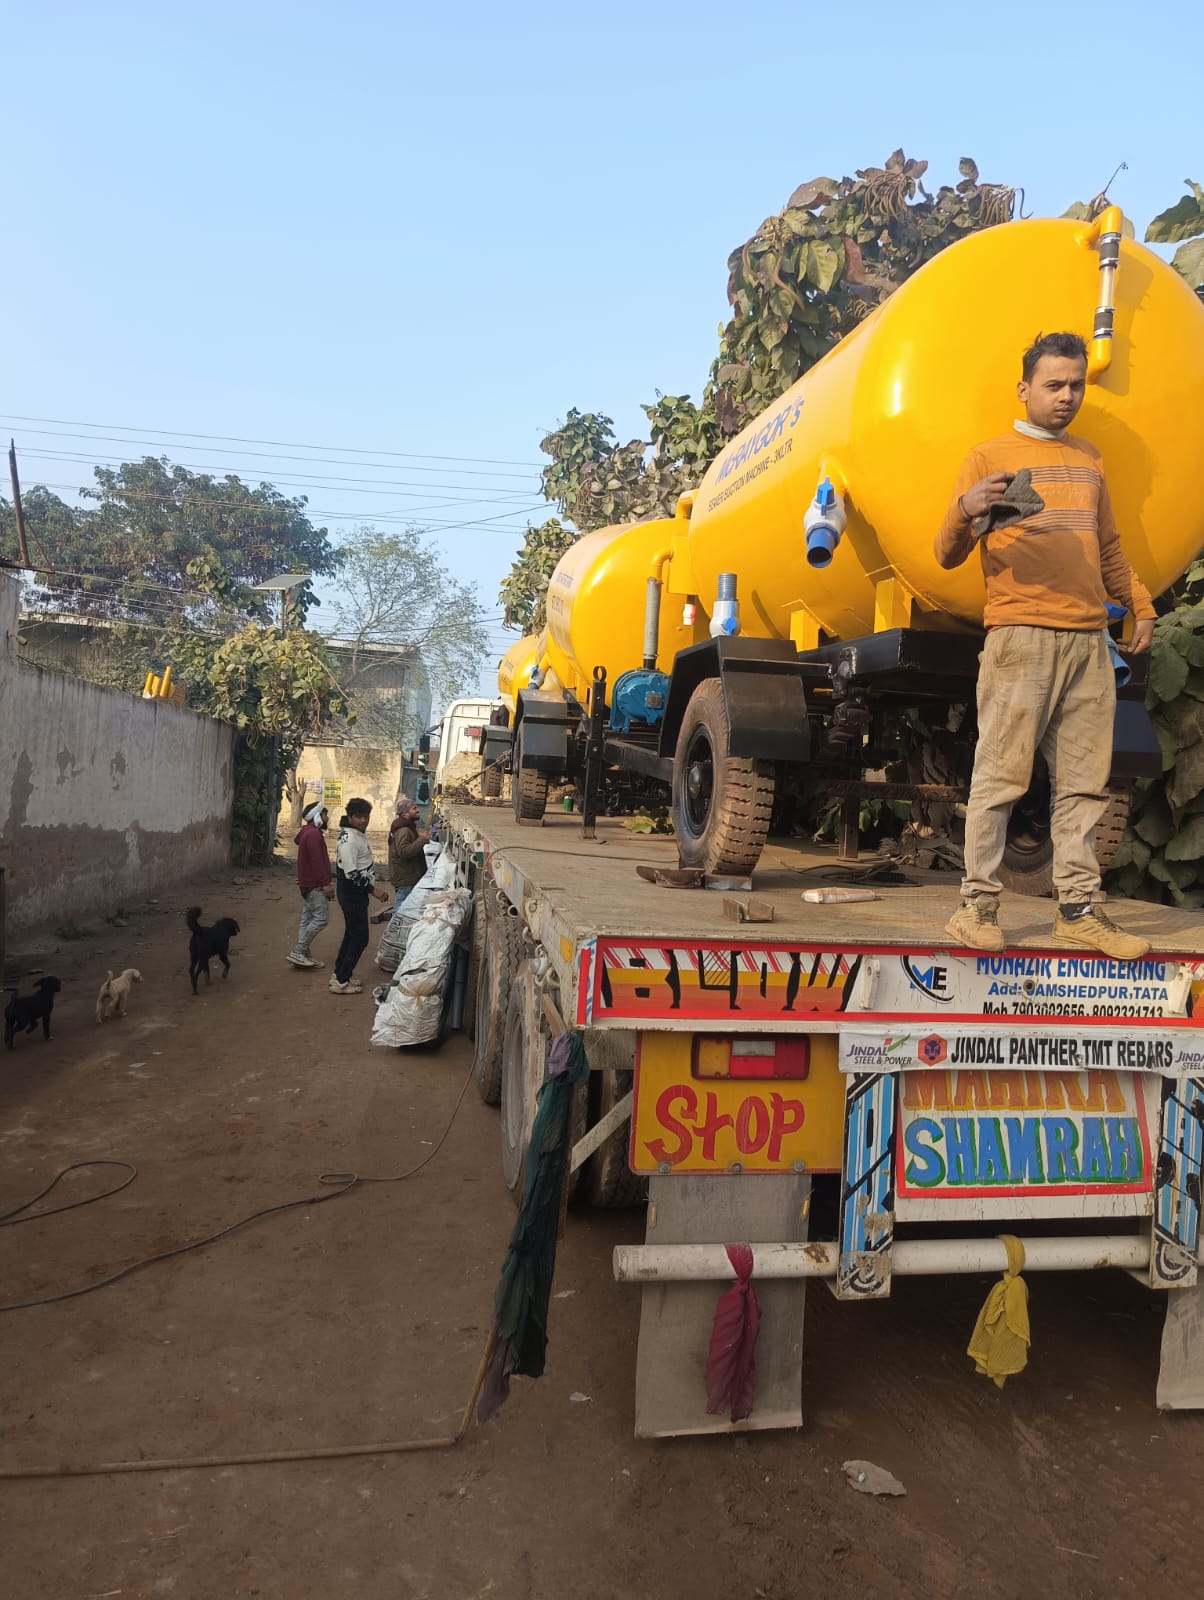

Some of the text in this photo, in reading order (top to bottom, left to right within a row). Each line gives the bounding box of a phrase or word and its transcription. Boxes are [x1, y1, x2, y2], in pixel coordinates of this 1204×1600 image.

[723, 475, 746, 500] SUCTION
[745, 455, 771, 486] MACHINE
[1057, 959, 1166, 982] ENGINEERING
[846, 1044, 888, 1057] JINDAL
[951, 1037, 1174, 1068] JINDAL PANTHER TMT REBARS
[1175, 1050, 1204, 1063] JINDA
[854, 1056, 913, 1065] STEEL & POWER
[1182, 1062, 1201, 1071] STEEL
[904, 1116, 1146, 1188] SHAMRAH
